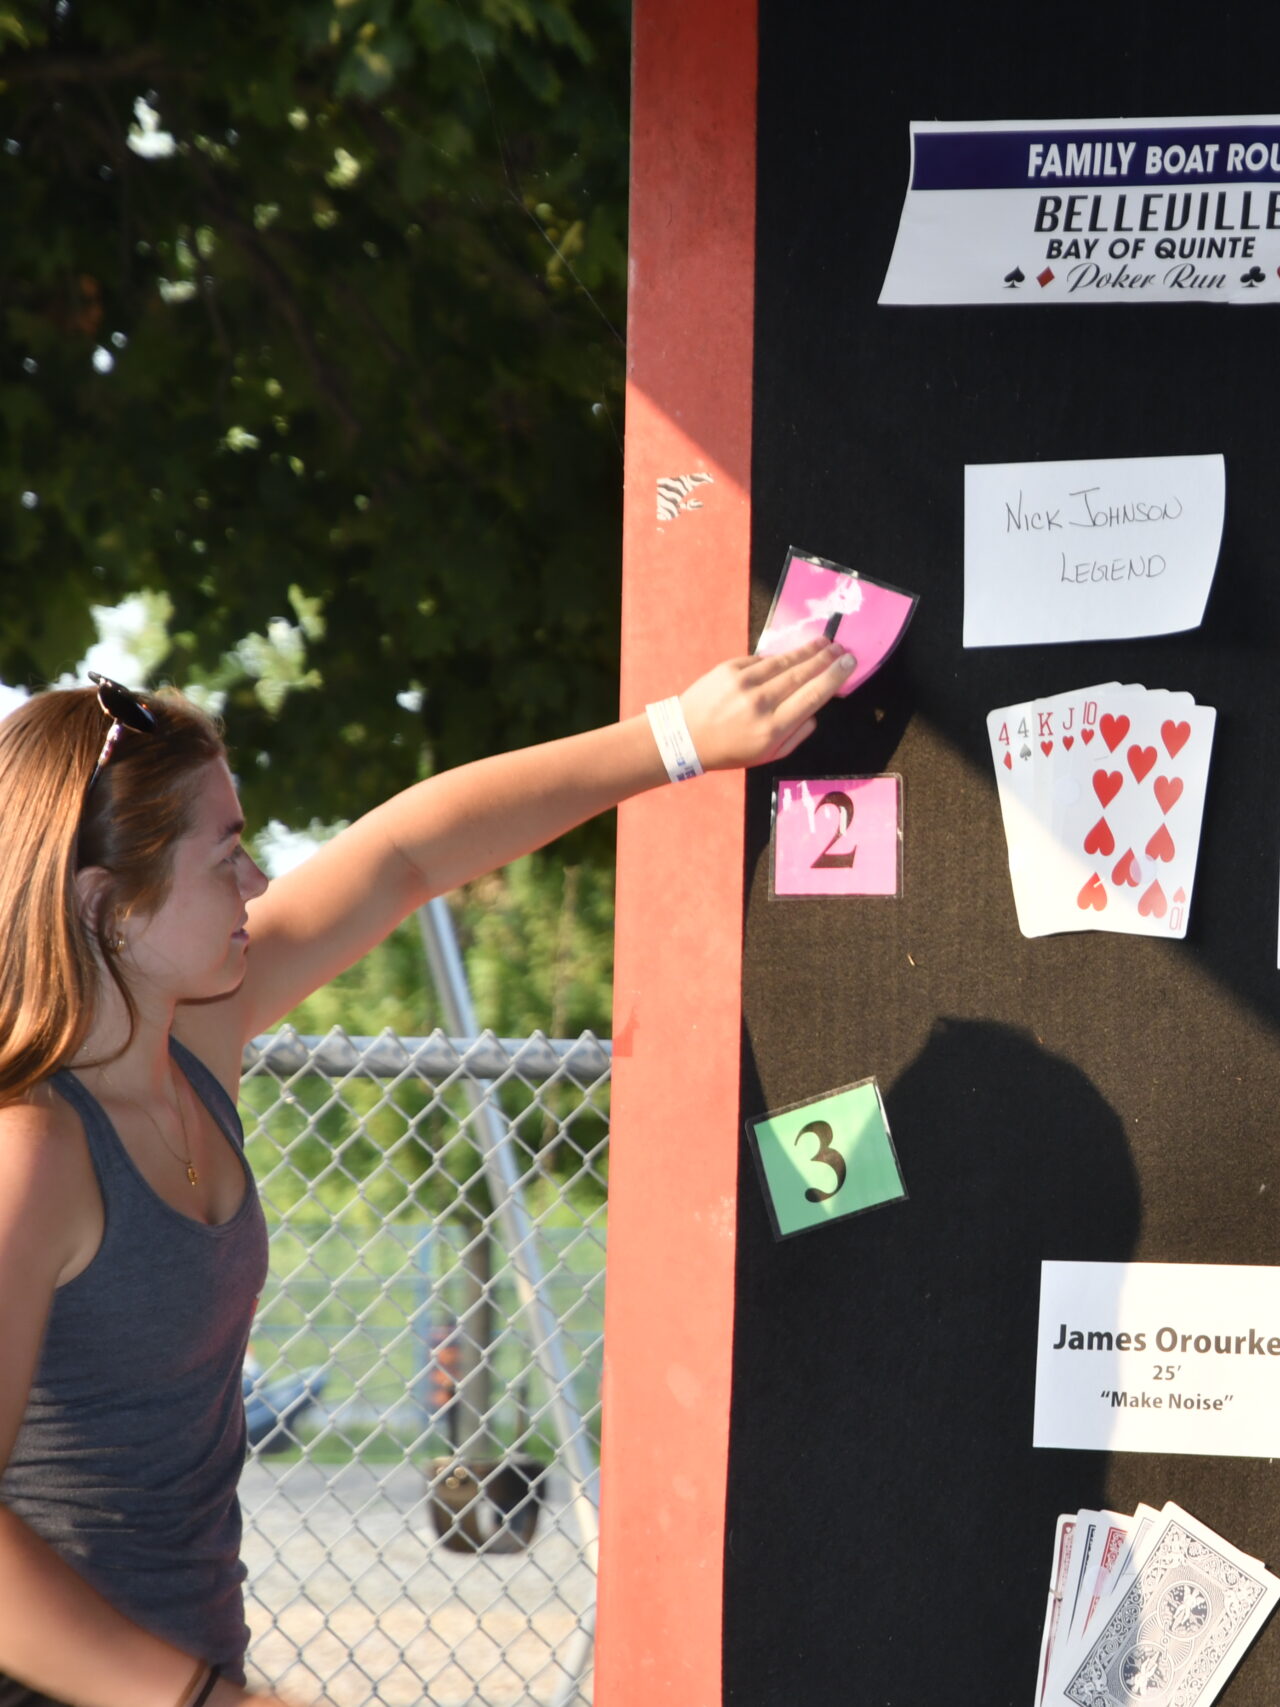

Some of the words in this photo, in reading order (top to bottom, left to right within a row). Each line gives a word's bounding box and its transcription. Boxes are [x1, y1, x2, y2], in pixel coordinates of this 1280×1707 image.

[1027, 141, 1137, 178] FAMILY
[1144, 143, 1220, 175] BOAT
[1045, 238, 1100, 260] BAY
[1107, 237, 1146, 260] OF
[1154, 236, 1256, 260] QUINTE
[1066, 262, 1156, 293] Poker
[1162, 262, 1227, 289] Run
[1068, 486, 1183, 528] JOHNSON
[1060, 551, 1167, 584] LEGEND
[998, 722, 1010, 746] 4
[1017, 717, 1029, 738] 4
[1037, 711, 1054, 737] K
[1062, 707, 1075, 730] J
[1082, 700, 1098, 726] 10
[811, 791, 858, 869] 2
[794, 1119, 848, 1204] 3
[1052, 1323, 1147, 1353] James
[1152, 1364, 1182, 1382] 25'
[1100, 1390, 1163, 1410] “Make
[1168, 1392, 1234, 1412] Noise”
